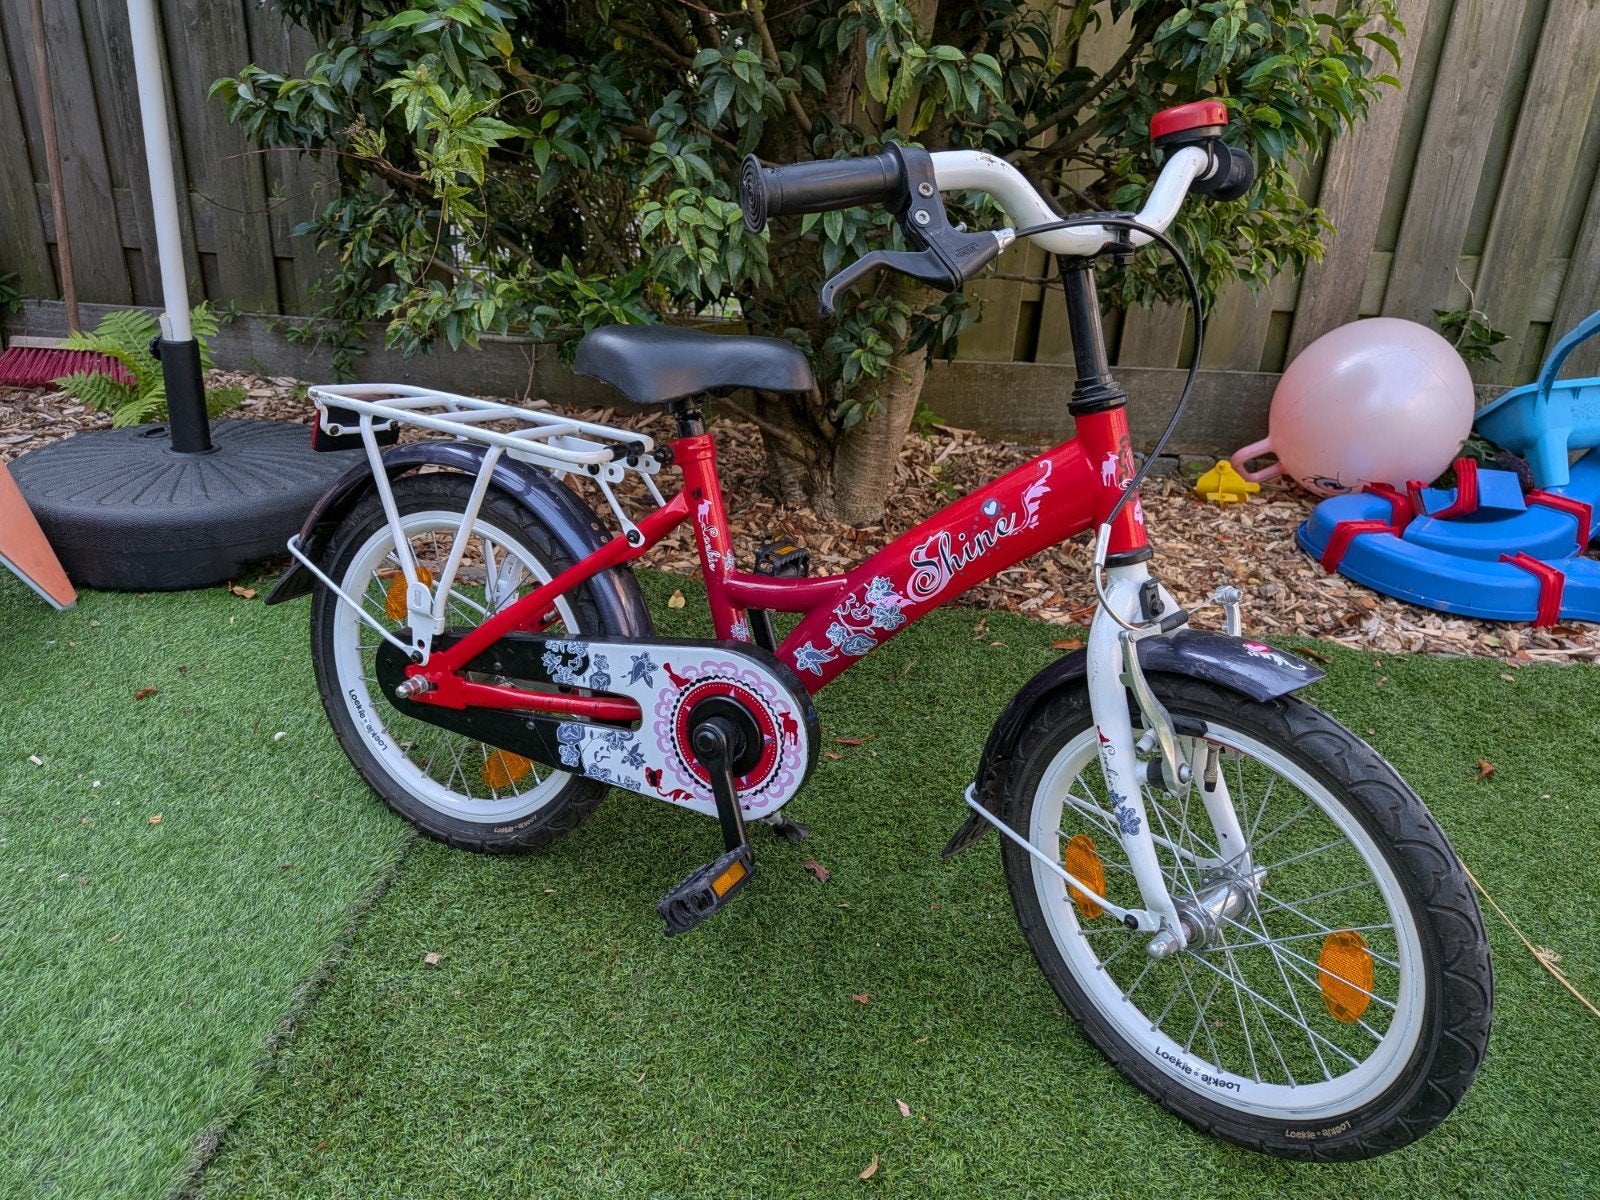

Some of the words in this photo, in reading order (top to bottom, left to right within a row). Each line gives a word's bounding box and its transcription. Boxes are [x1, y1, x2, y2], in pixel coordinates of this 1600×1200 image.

[908, 511, 1017, 596] Shine
[348, 688, 366, 719] Loekie
[366, 723, 388, 751] Loekie
[1155, 1045, 1193, 1076] Loekie
[1201, 1071, 1241, 1093] Loekie
[1285, 1129, 1317, 1140] Loekie
[1321, 1119, 1352, 1137] Loekie
